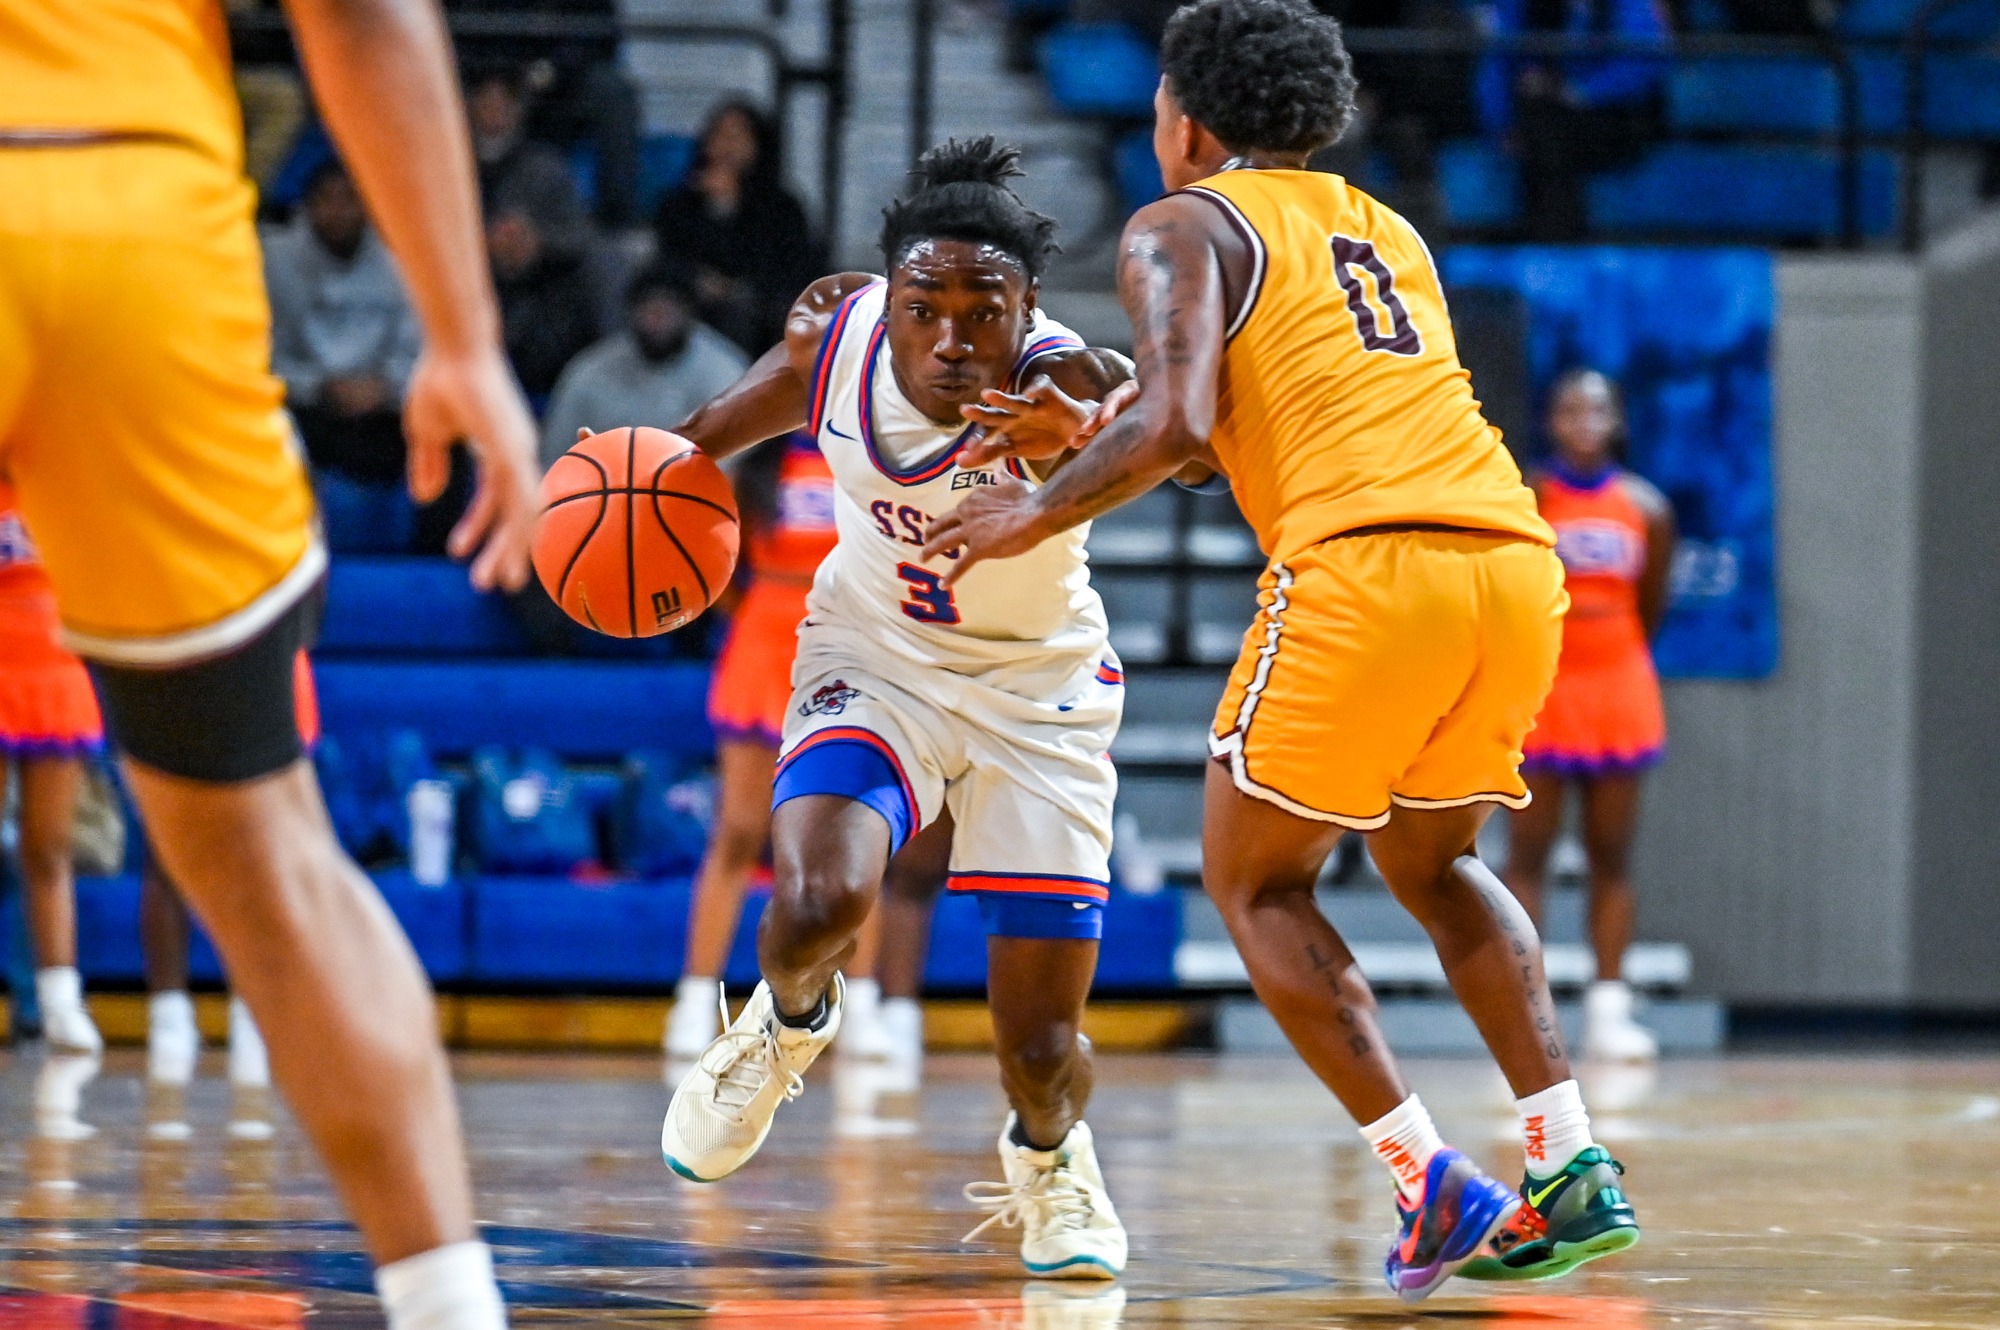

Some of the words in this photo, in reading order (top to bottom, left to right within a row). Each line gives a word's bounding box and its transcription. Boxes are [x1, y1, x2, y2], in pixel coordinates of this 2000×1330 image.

[1331, 232, 1426, 357] 0
[870, 499, 960, 560] SS
[896, 561, 962, 625] 3
